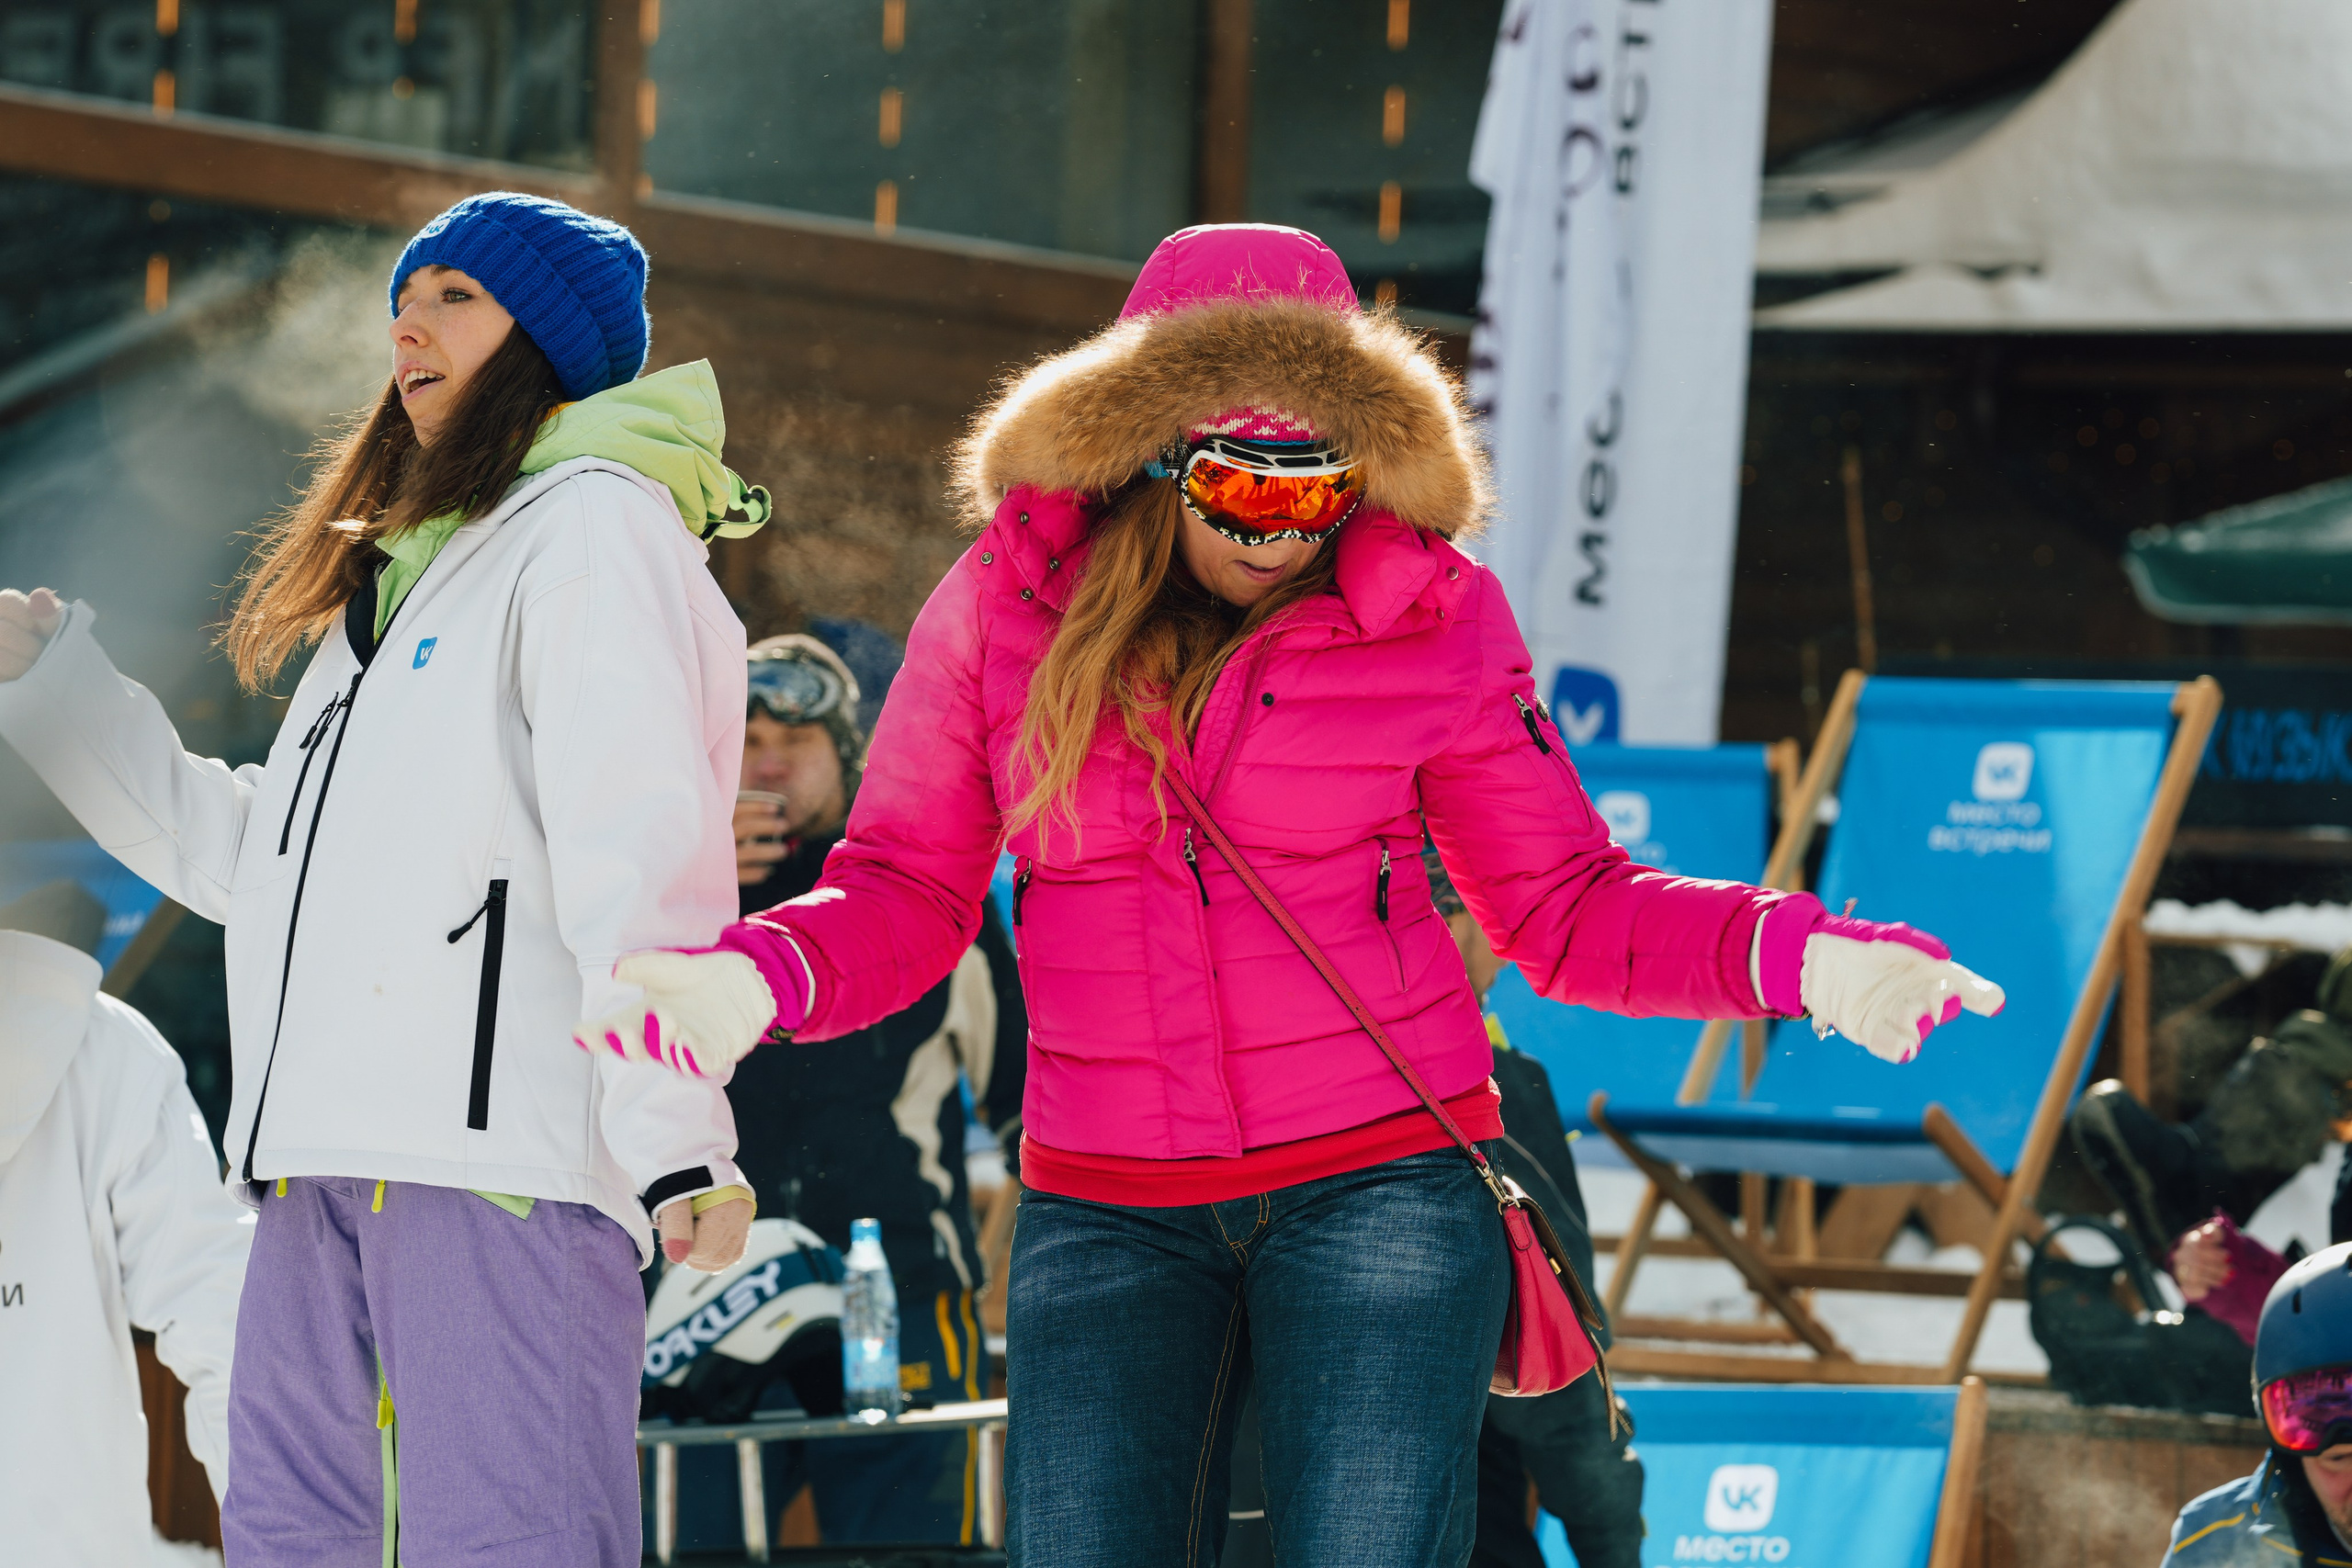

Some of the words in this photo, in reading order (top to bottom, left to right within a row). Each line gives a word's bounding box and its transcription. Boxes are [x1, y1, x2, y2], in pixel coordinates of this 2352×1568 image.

[419, 645, 434, 661] VK
[644, 1259, 781, 1378] OAKLEY
[1722, 1484, 1762, 1512] VK
